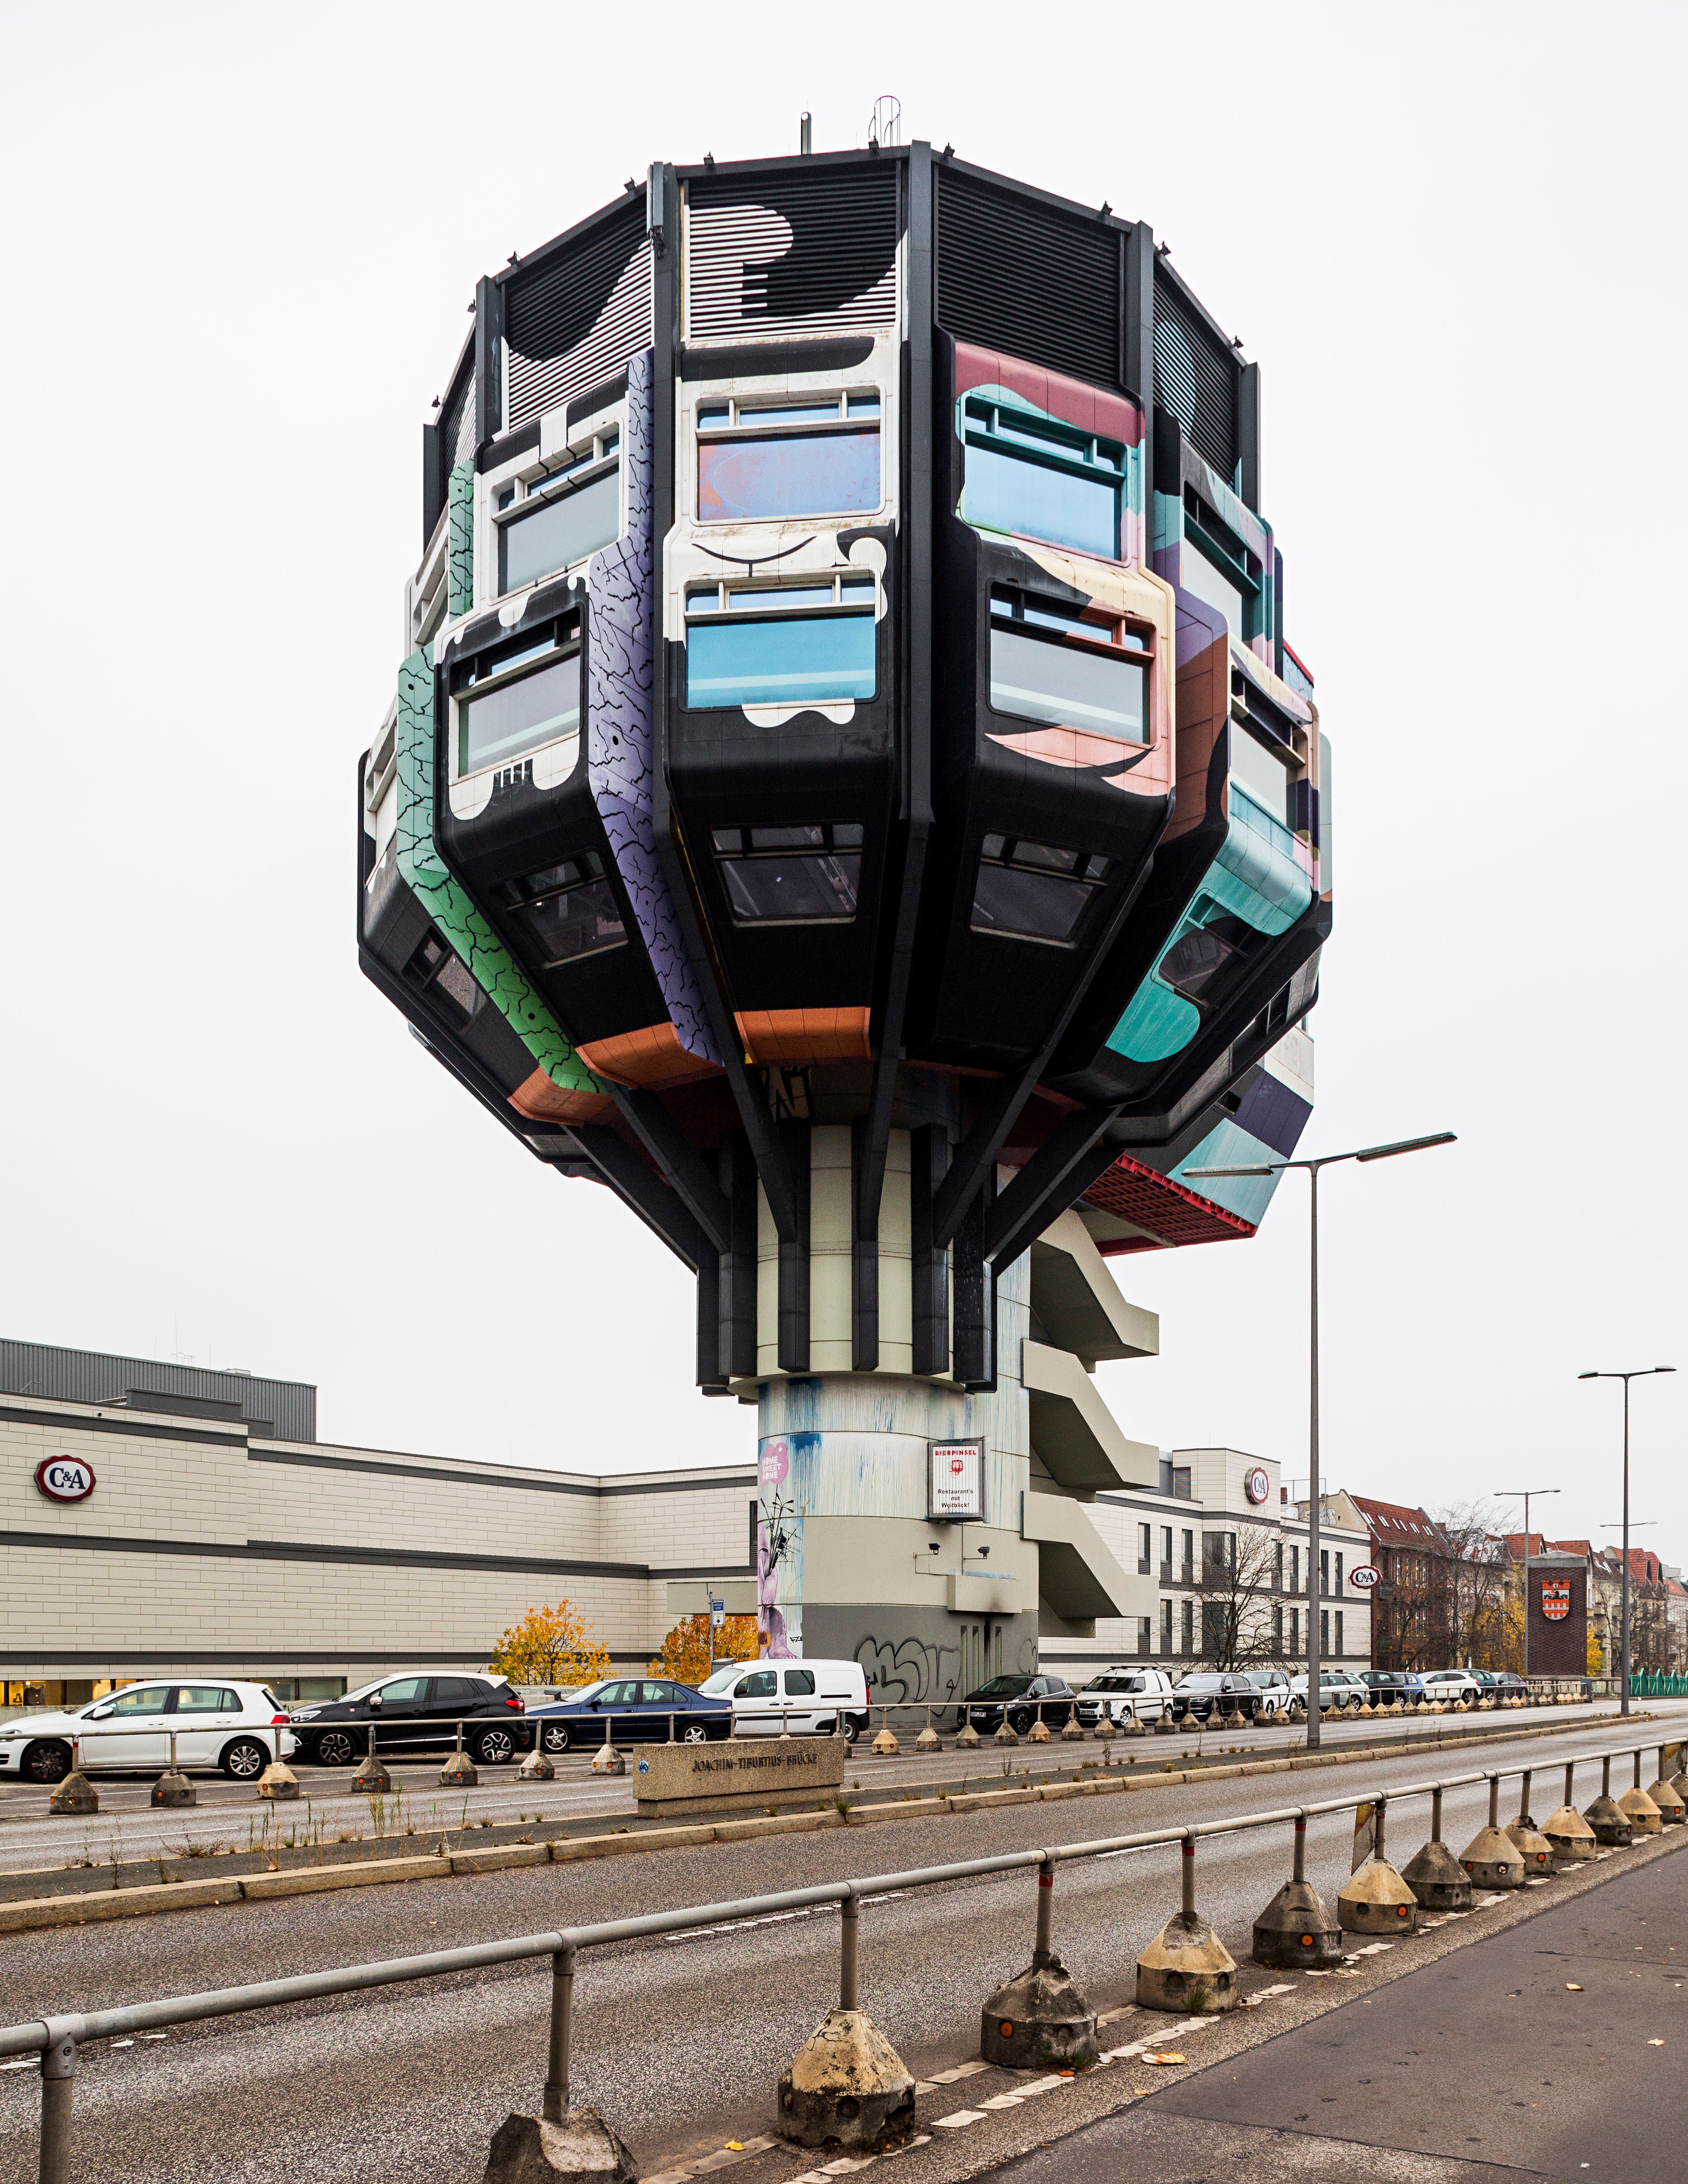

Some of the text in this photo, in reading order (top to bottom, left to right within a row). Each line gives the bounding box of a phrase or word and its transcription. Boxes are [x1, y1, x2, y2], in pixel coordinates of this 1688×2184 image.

[762, 1456, 778, 1466] HOME
[762, 1463, 782, 1473] SWEET
[49, 1467, 86, 1489] C&A
[762, 1472, 778, 1481] HOME
[1254, 1477, 1266, 1494] C&A
[1355, 1572, 1375, 1582] C&A
[692, 1752, 818, 1772] JOACHIM-TIBURTIUS-BRÜCKE
